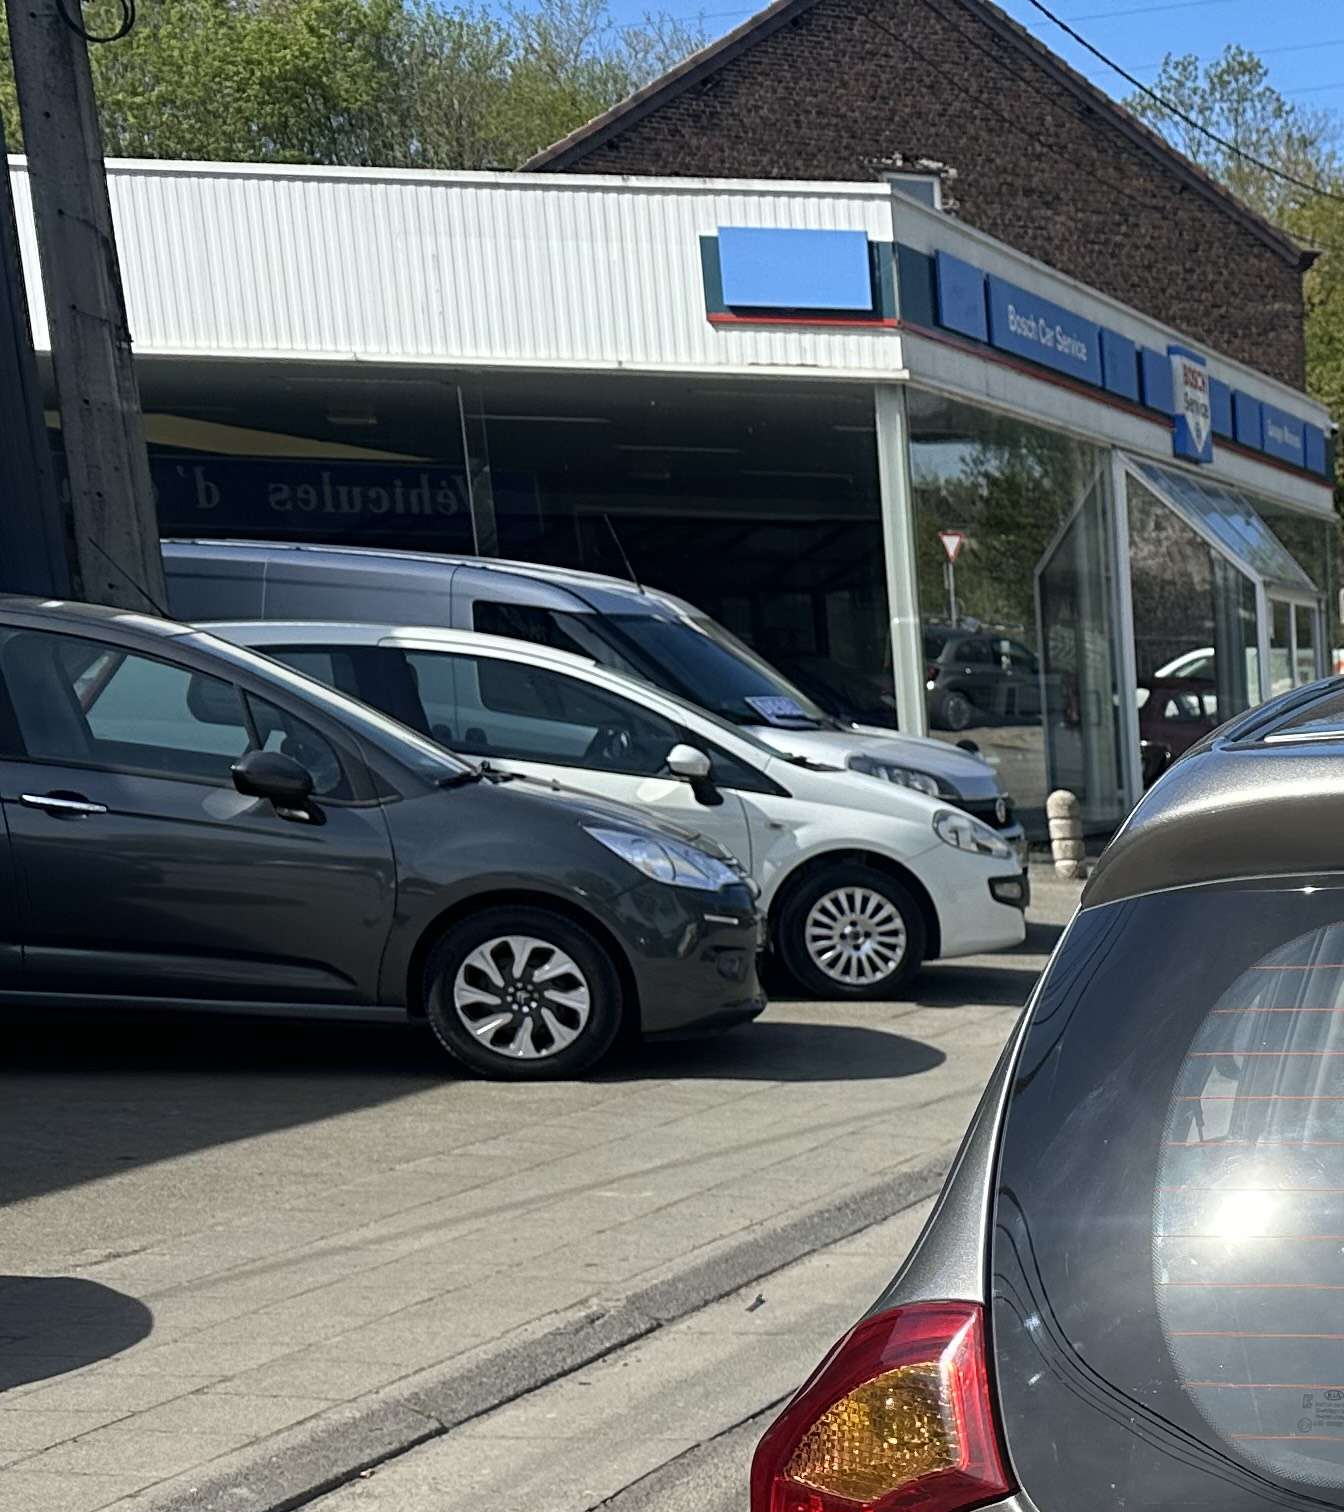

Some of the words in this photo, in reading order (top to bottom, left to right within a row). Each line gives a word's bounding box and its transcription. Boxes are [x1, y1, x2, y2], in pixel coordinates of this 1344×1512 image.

[1007, 303, 1039, 341] Bosch
[1039, 318, 1055, 347] Car
[1056, 325, 1087, 362] Service
[1183, 363, 1207, 393] BOSCH
